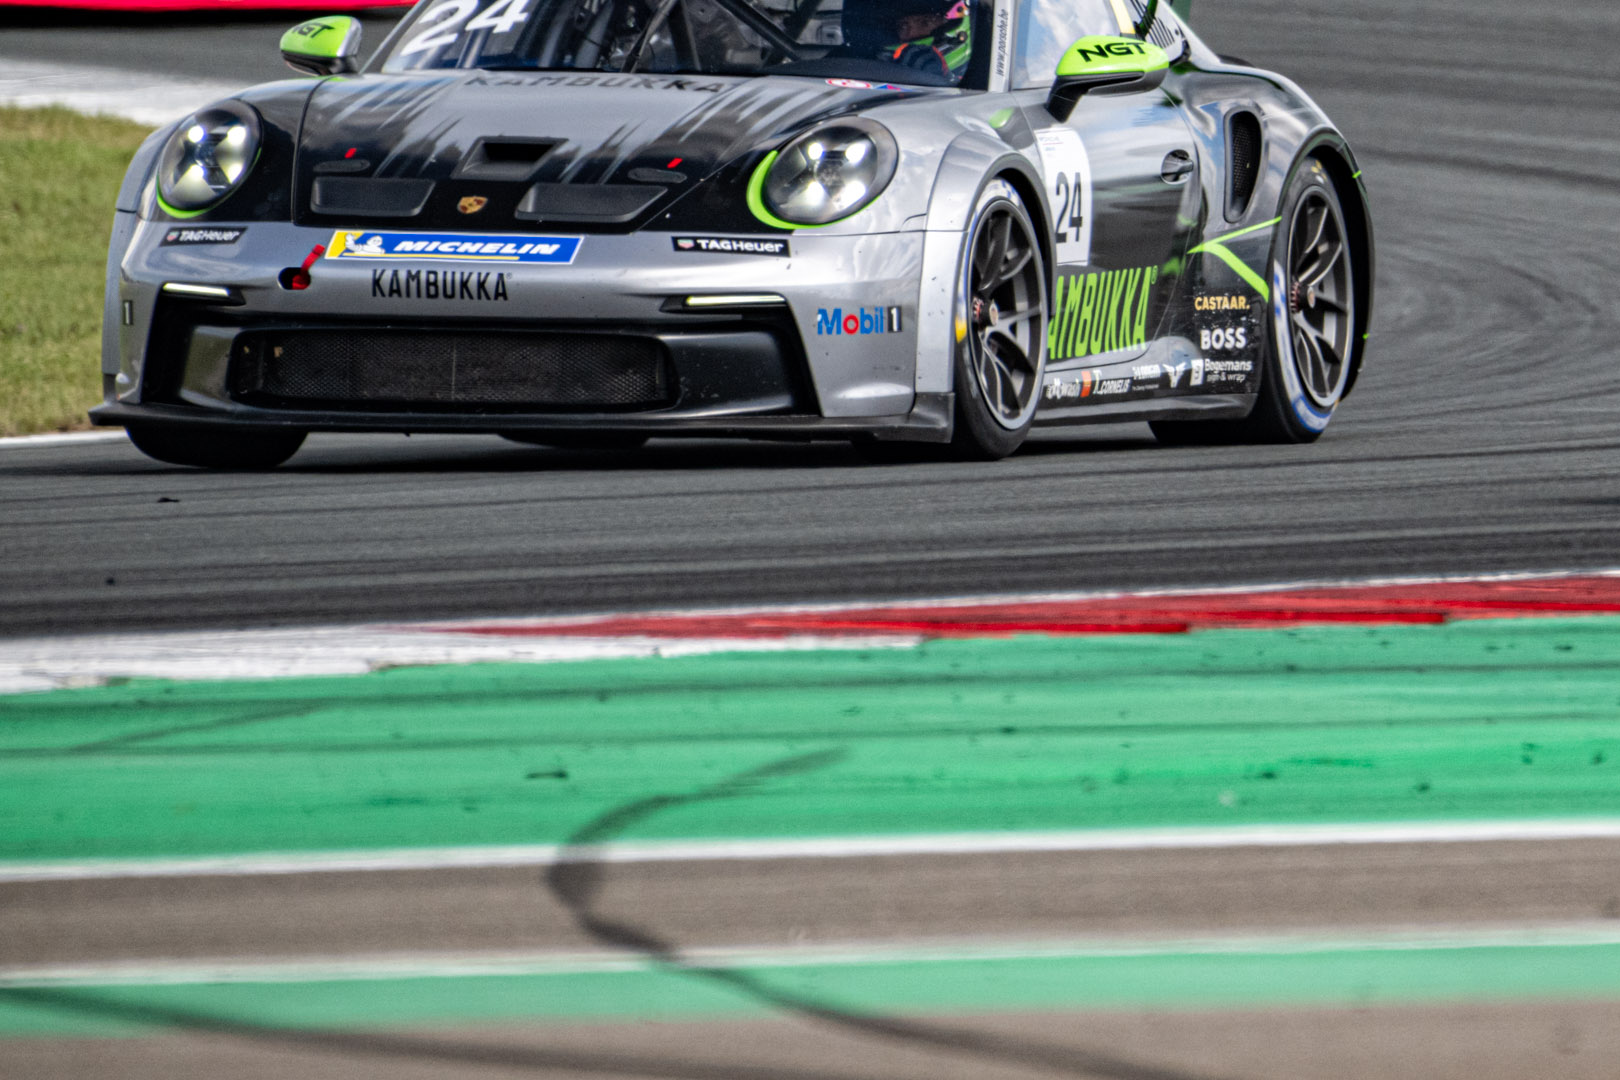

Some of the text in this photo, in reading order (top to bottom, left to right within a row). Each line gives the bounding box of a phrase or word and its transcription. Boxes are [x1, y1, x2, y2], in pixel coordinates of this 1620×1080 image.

[996, 9, 1009, 76] www.porsche.be
[1077, 41, 1149, 62] NGT
[1055, 171, 1084, 245] 24
[393, 240, 561, 256] MICHELIN
[817, 306, 884, 335] Mobil
[1200, 327, 1247, 350] BOSS
[1204, 358, 1252, 376] Bogemans
